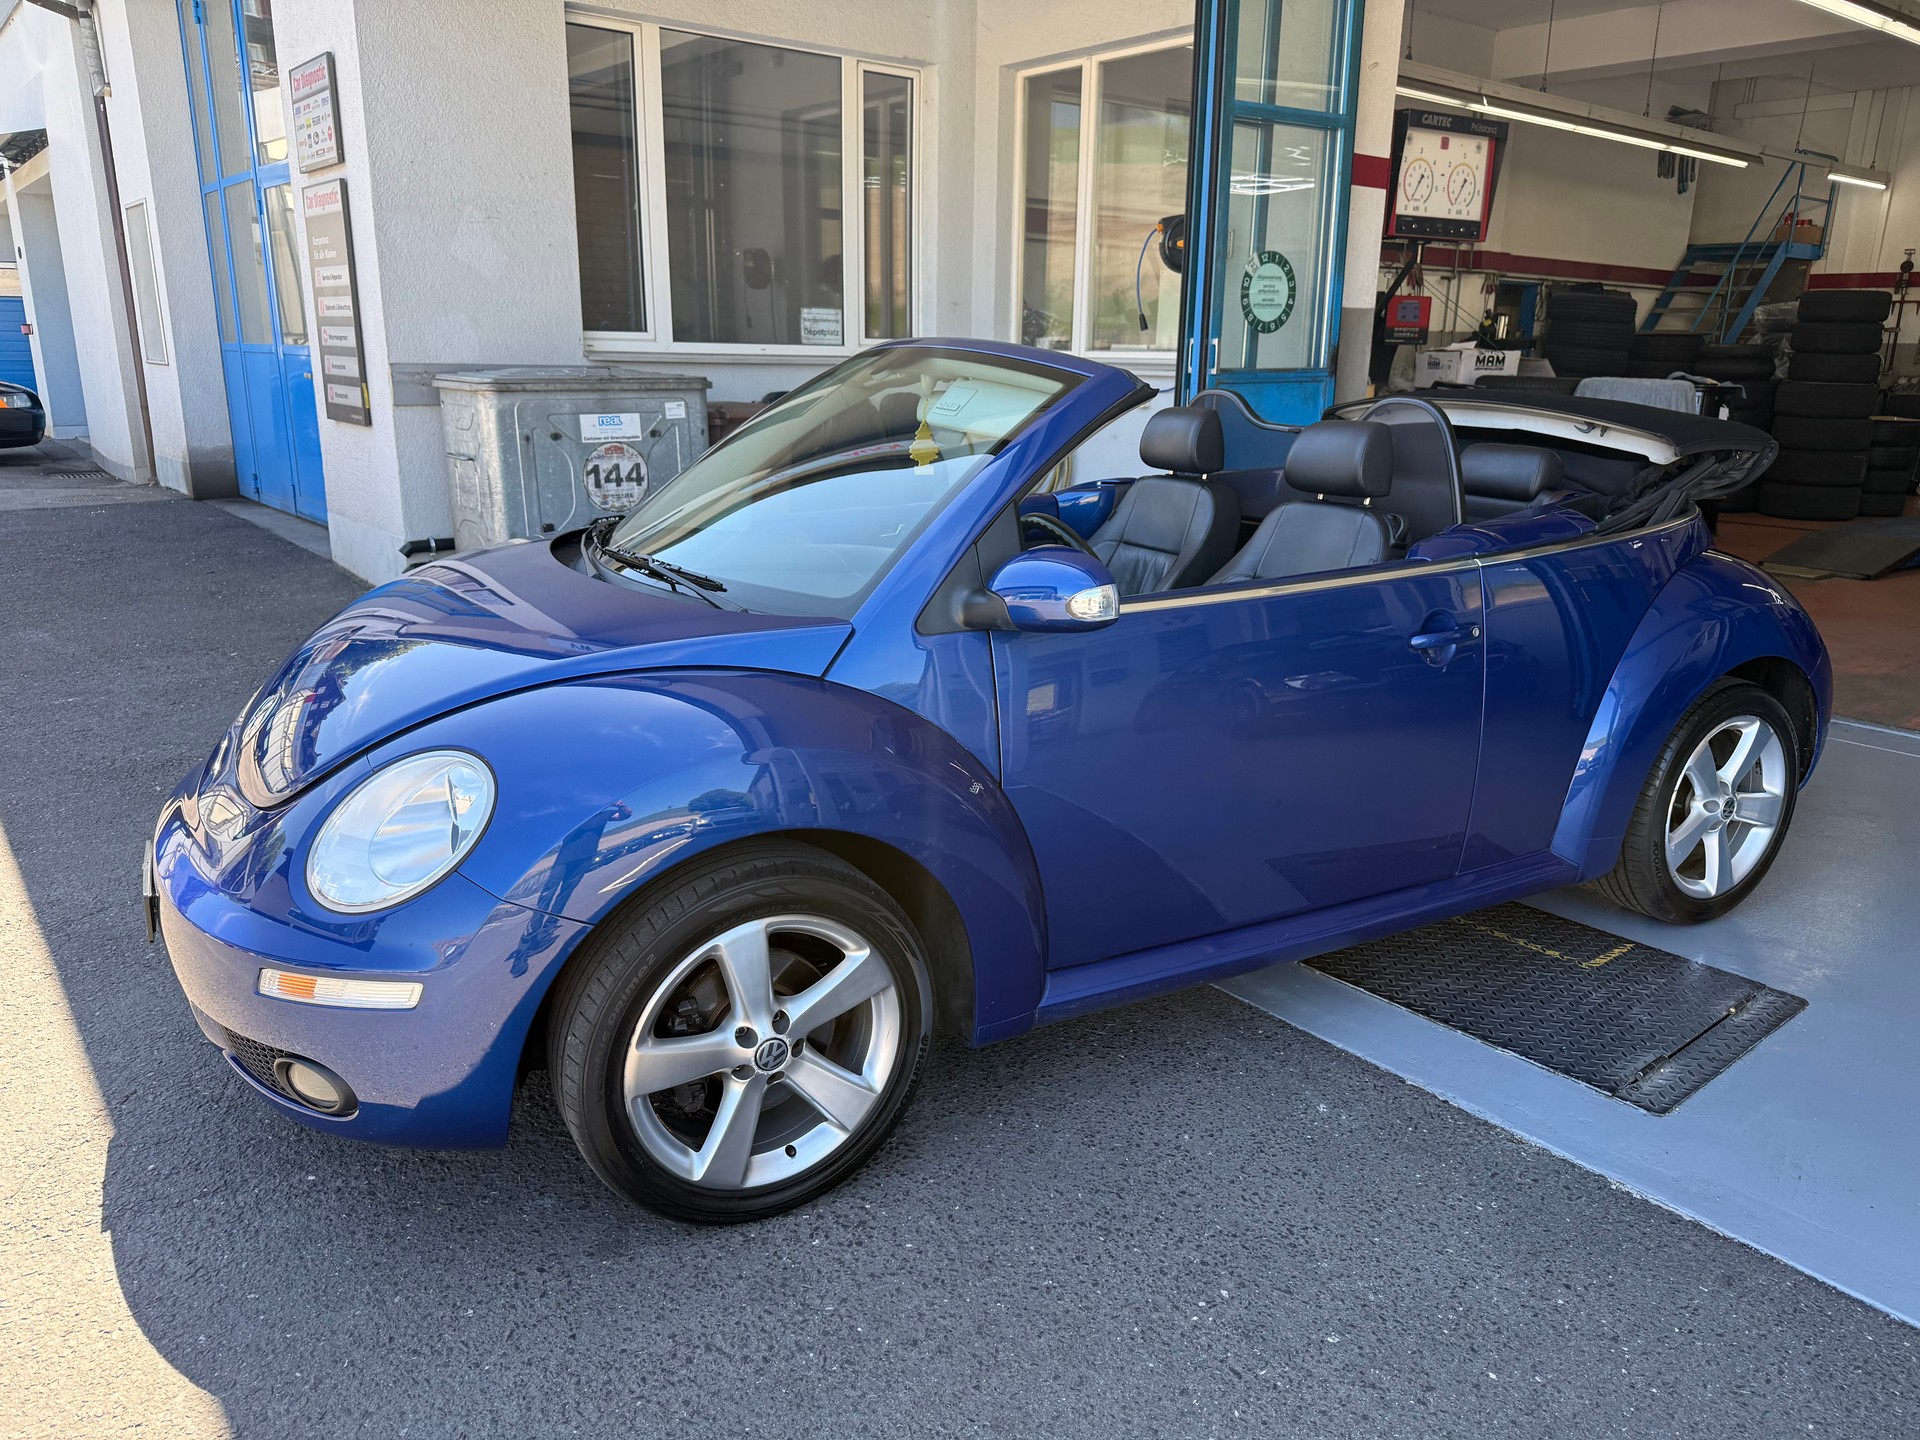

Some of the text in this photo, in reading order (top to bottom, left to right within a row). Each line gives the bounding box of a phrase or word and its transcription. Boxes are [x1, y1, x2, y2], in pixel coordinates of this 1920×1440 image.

[293, 63, 326, 92] Car Diagnostic
[1421, 113, 1453, 128] CARTEC
[305, 187, 339, 211] Car Diagnostic
[1261, 254, 1268, 262] 12
[1244, 278, 1250, 287] 10
[1475, 355, 1506, 367] MAM
[586, 462, 645, 489] 144
